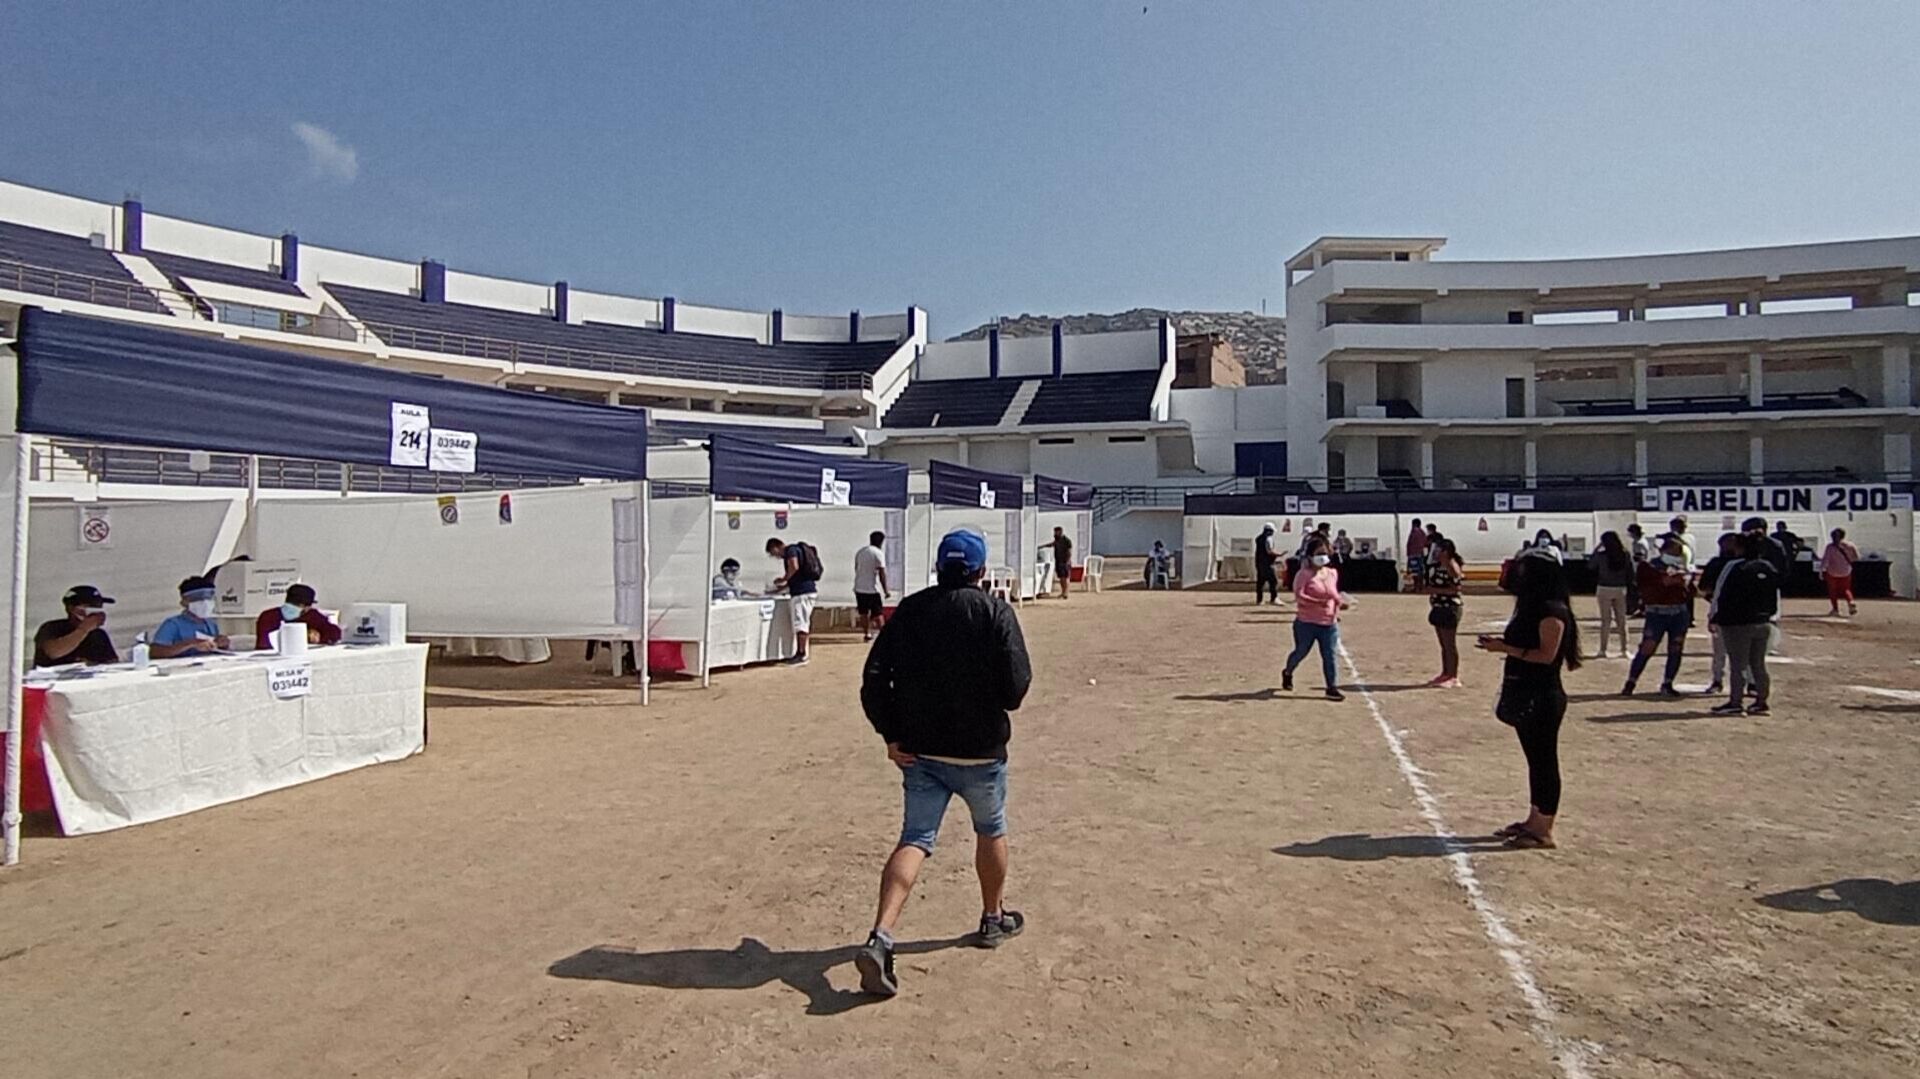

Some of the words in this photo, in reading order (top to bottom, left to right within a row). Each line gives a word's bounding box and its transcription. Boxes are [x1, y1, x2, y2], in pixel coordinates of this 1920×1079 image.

[400, 429, 422, 450] 214
[437, 436, 472, 449] 039442
[1666, 488, 1812, 512] PABELLON
[1826, 487, 1889, 512] 200
[275, 669, 296, 678] MESA
[272, 676, 309, 691] 039442
